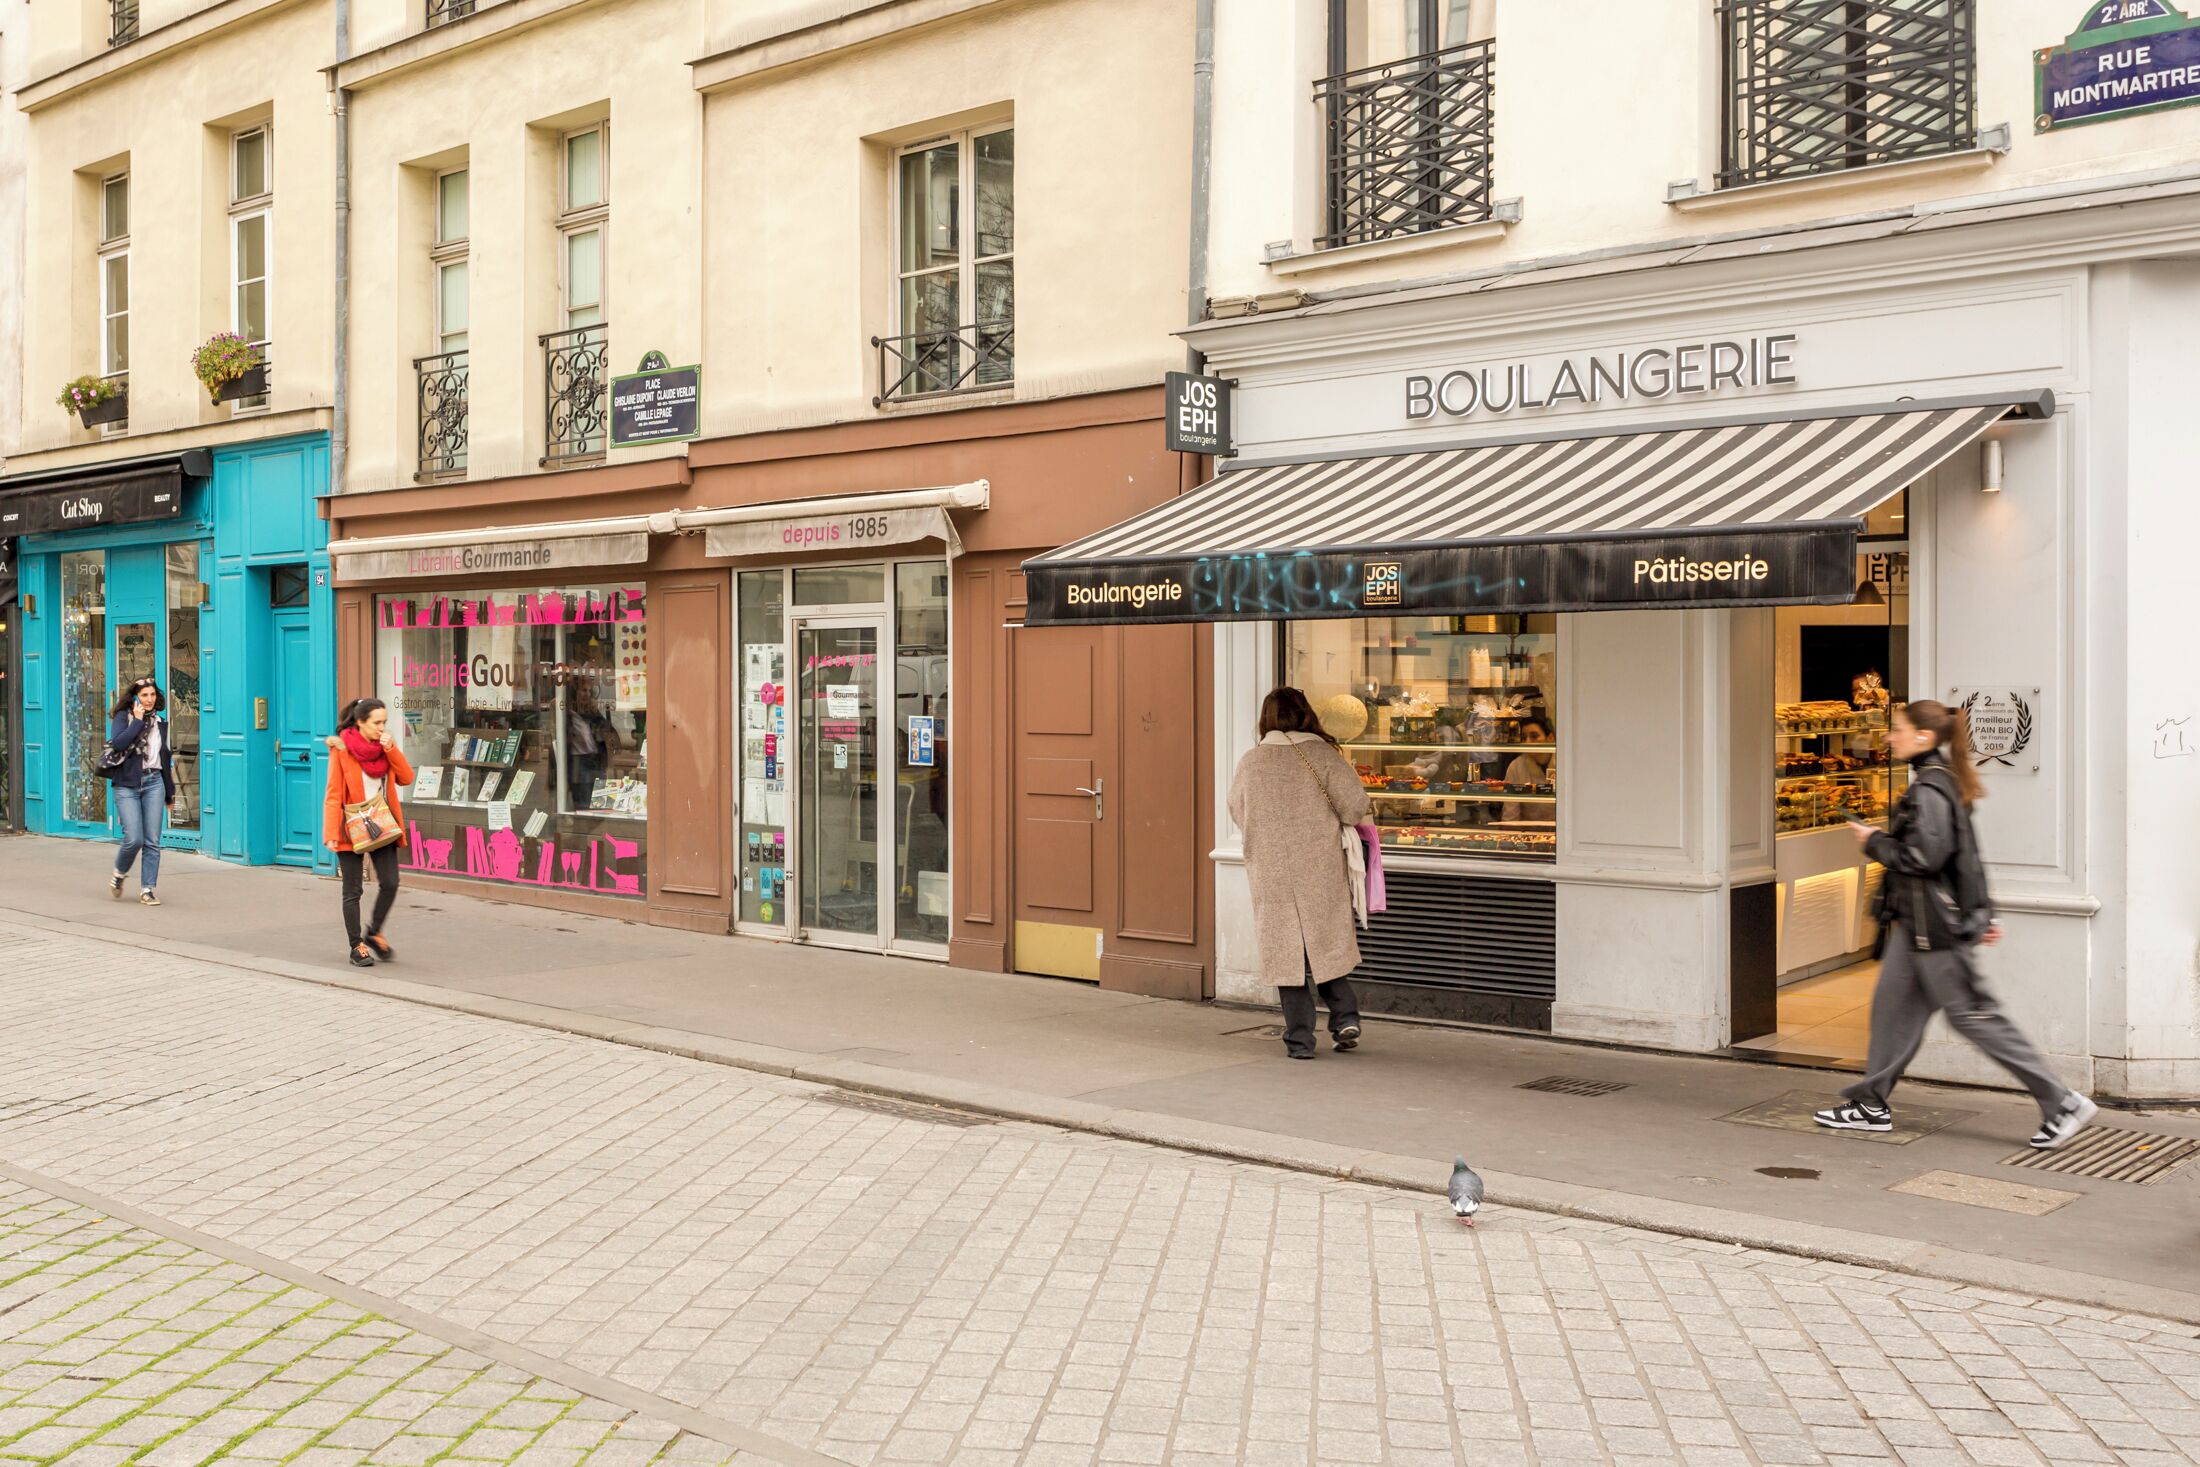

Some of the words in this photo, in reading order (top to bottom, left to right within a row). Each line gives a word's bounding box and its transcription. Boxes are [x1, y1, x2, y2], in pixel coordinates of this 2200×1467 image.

[2098, 46, 2152, 73] RUE
[2053, 65, 2200, 109] MONTMARTRE
[645, 378, 661, 390] PLACE
[1405, 333, 1798, 421] BOULANGERIE
[614, 394, 636, 407] GHISLAINE
[636, 391, 655, 404] DUPONT
[656, 388, 677, 401] CLAUDE
[676, 385, 696, 398] VERLON
[1179, 380, 1217, 408] JOS
[634, 409, 654, 421] CAMILLE
[653, 407, 673, 419] LEPAGE
[1179, 406, 1217, 435] EPH
[1179, 433, 1217, 446] boulangerie
[154, 493, 171, 503] BEAUTY
[61, 499, 78, 519] Cut
[79, 497, 103, 522] Shop
[783, 521, 840, 547] depuis
[847, 516, 888, 539] 1985
[1366, 565, 1398, 581] JOS
[1633, 553, 1769, 584] Pâtisserie
[316, 575, 324, 585] 94
[1366, 580, 1398, 596] EPH
[1067, 578, 1182, 609] Boulangerie
[1366, 594, 1398, 603] boulangerie
[393, 696, 441, 710] Gastronomie
[1975, 716, 2013, 724] meilleur
[1975, 726, 1996, 734] PAIN
[1998, 726, 2014, 734] BIO
[1984, 743, 2004, 751] 2019
